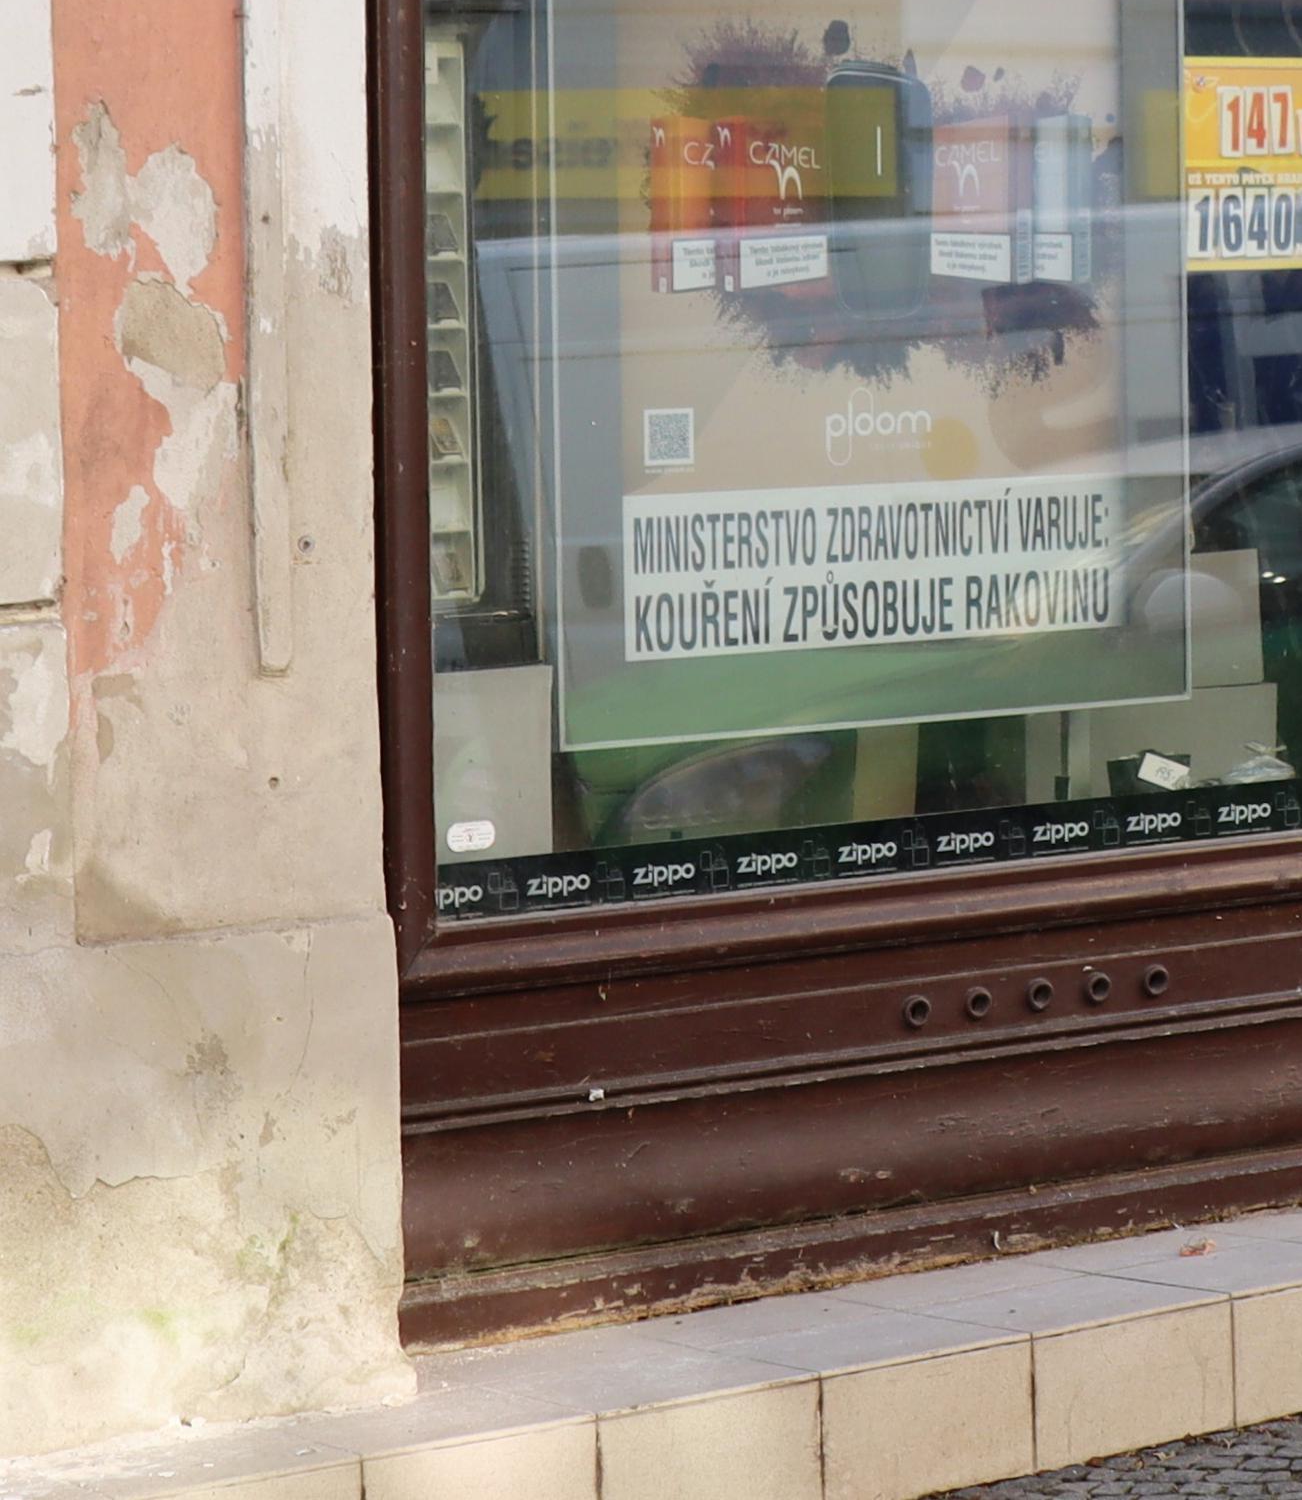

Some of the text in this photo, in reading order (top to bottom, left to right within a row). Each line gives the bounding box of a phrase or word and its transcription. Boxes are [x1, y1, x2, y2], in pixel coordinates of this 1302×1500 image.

[749, 140, 822, 170] CAMEL
[934, 140, 1000, 167] CAMEL
[1226, 91, 1289, 152] 147
[826, 391, 932, 464] ploom
[633, 488, 1109, 575] MINISTERSTVO ZDRAVOTNICTVÍ VARUJE:
[635, 566, 1110, 652] KOUŘENÍ ZPŮSOBUJE RAKOVINU
[527, 873, 590, 898] zippo
[632, 862, 695, 887] zippo
[737, 852, 798, 876] zippo
[838, 841, 897, 864] zippo
[936, 831, 995, 854] zippo
[1033, 821, 1089, 844] zippo
[1127, 811, 1181, 834] zippo
[1217, 802, 1271, 824] zippo
